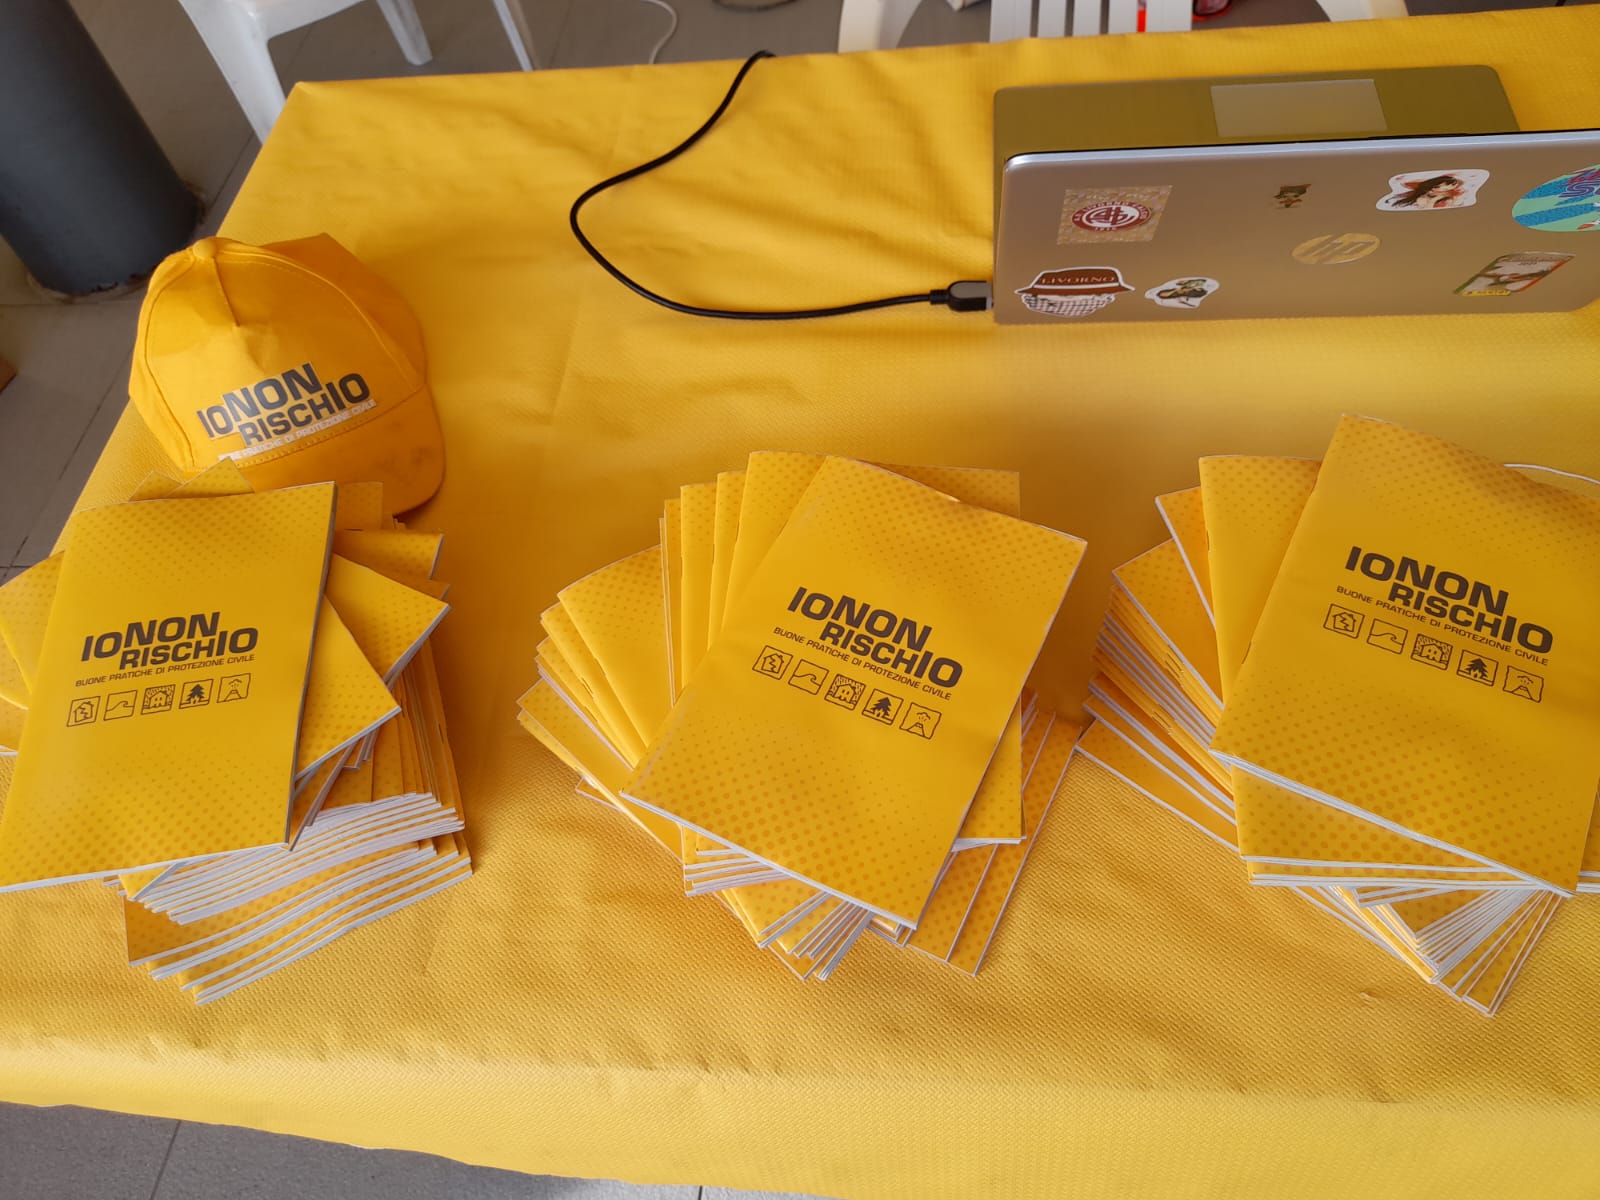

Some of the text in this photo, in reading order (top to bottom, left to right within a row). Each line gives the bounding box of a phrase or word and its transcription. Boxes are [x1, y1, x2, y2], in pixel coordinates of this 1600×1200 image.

[1040, 275, 1116, 285] LIVORNO
[238, 373, 371, 446] RISCHIO
[119, 627, 259, 670] RISCHIO
[1336, 585, 1549, 666] BUONE PRATICHE DI PROTEZIONE CIVILE
[1388, 582, 1553, 654] RISCHIO
[75, 654, 255, 687] BUONE PRATICHE DI PROTEZIONE CIVILE
[773, 627, 953, 701] BUONE PRATICHE DI PROTEZIONE CIVILE
[819, 621, 963, 688] RISCHIO
